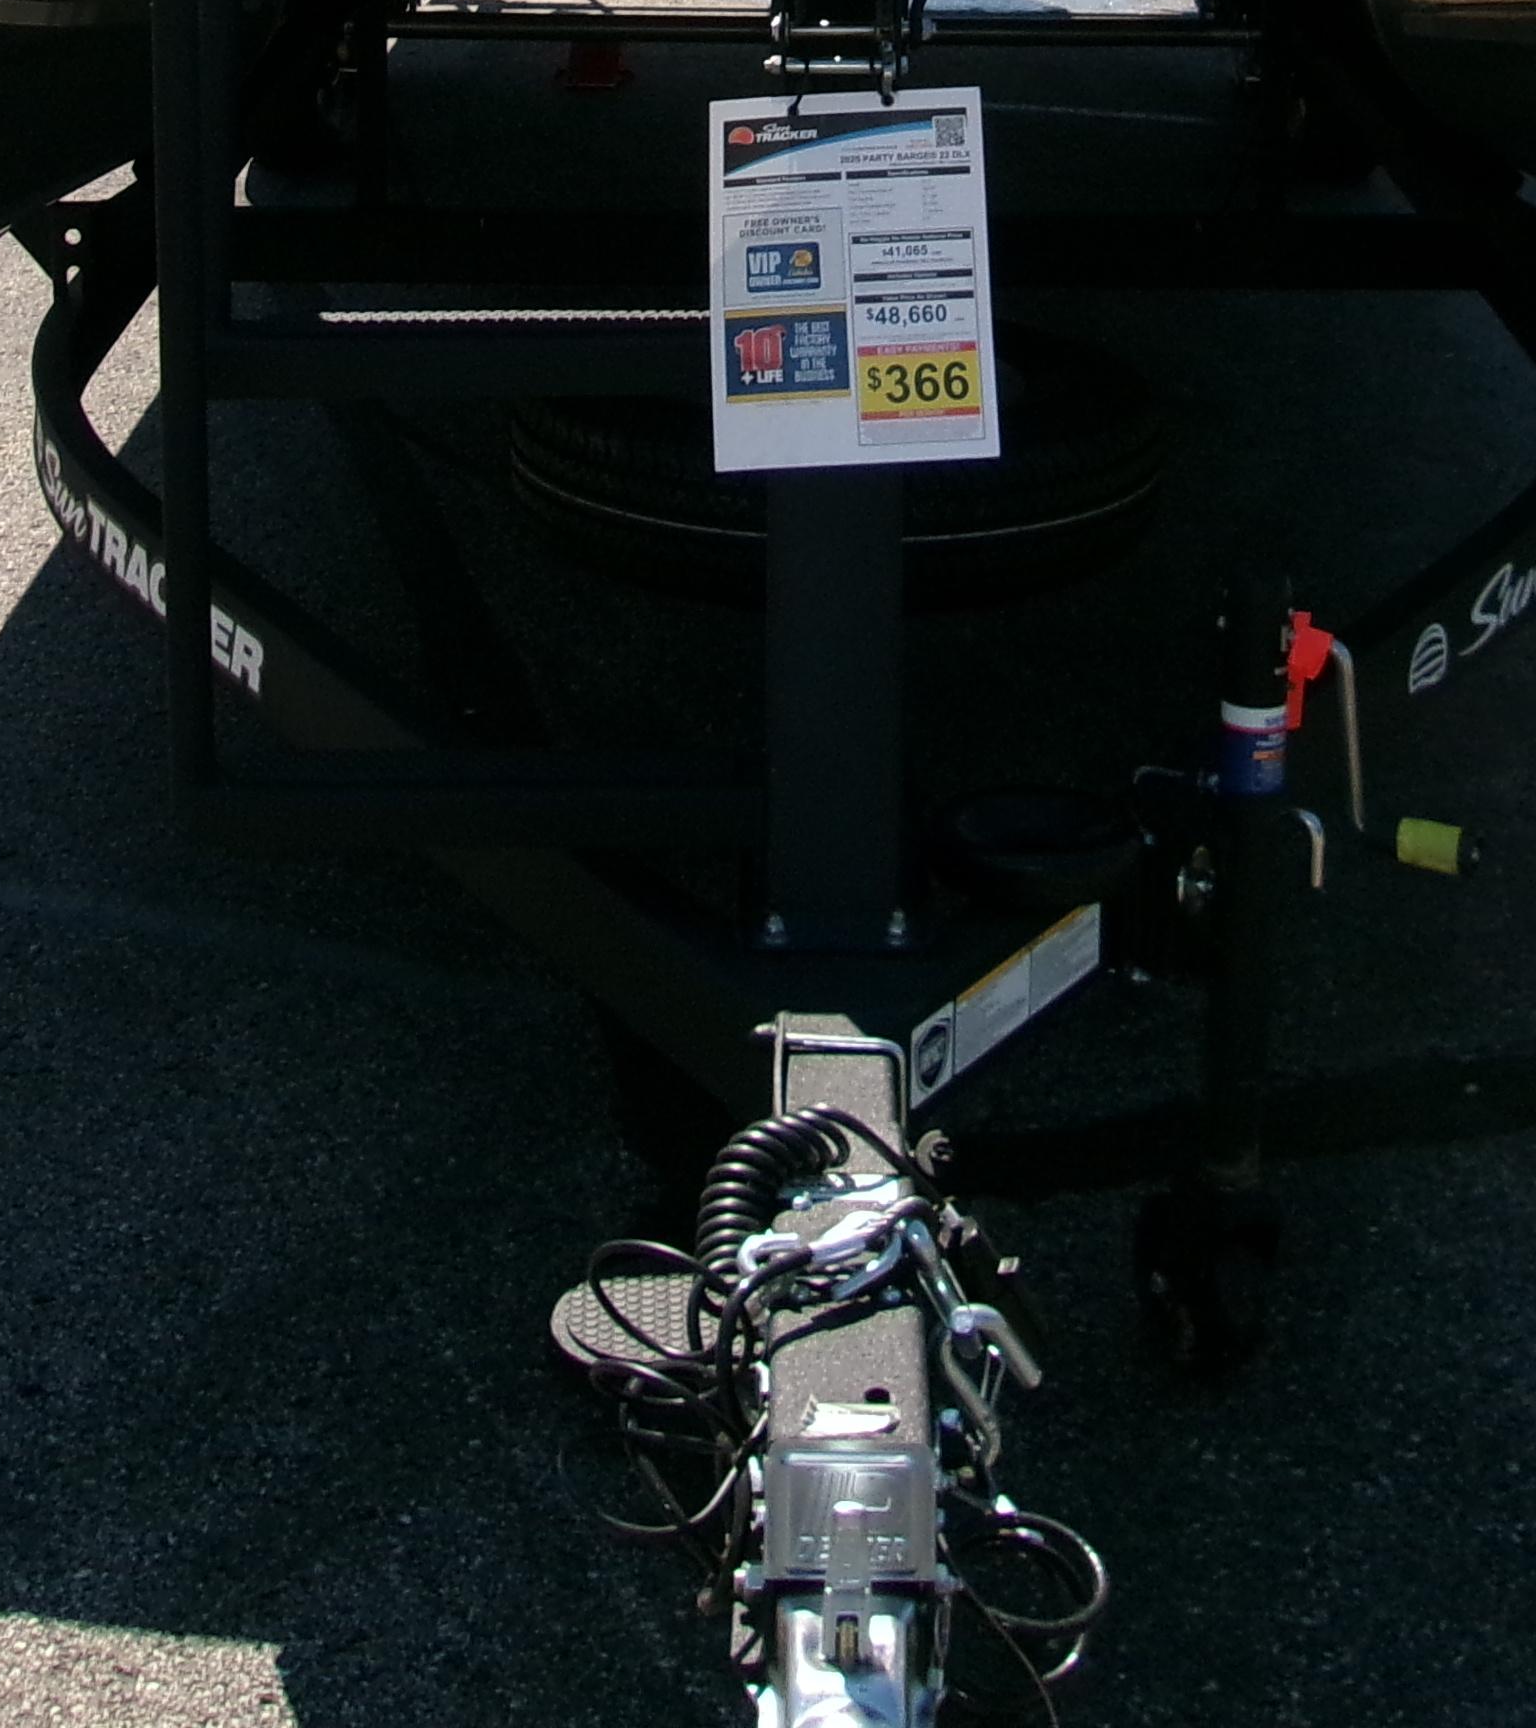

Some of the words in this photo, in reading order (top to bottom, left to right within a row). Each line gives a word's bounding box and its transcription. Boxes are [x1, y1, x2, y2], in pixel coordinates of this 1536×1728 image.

[756, 129, 817, 143] TRACKER
[863, 153, 894, 163] PARTY
[744, 218, 769, 228] FREE
[772, 216, 820, 226] OWNER'S
[740, 227, 789, 238] DISCOUNT
[748, 251, 781, 275] VIP
[866, 304, 947, 328] $48,660
[757, 370, 783, 383] LIFE
[867, 361, 969, 404] $366
[86, 494, 264, 694] TRACER
